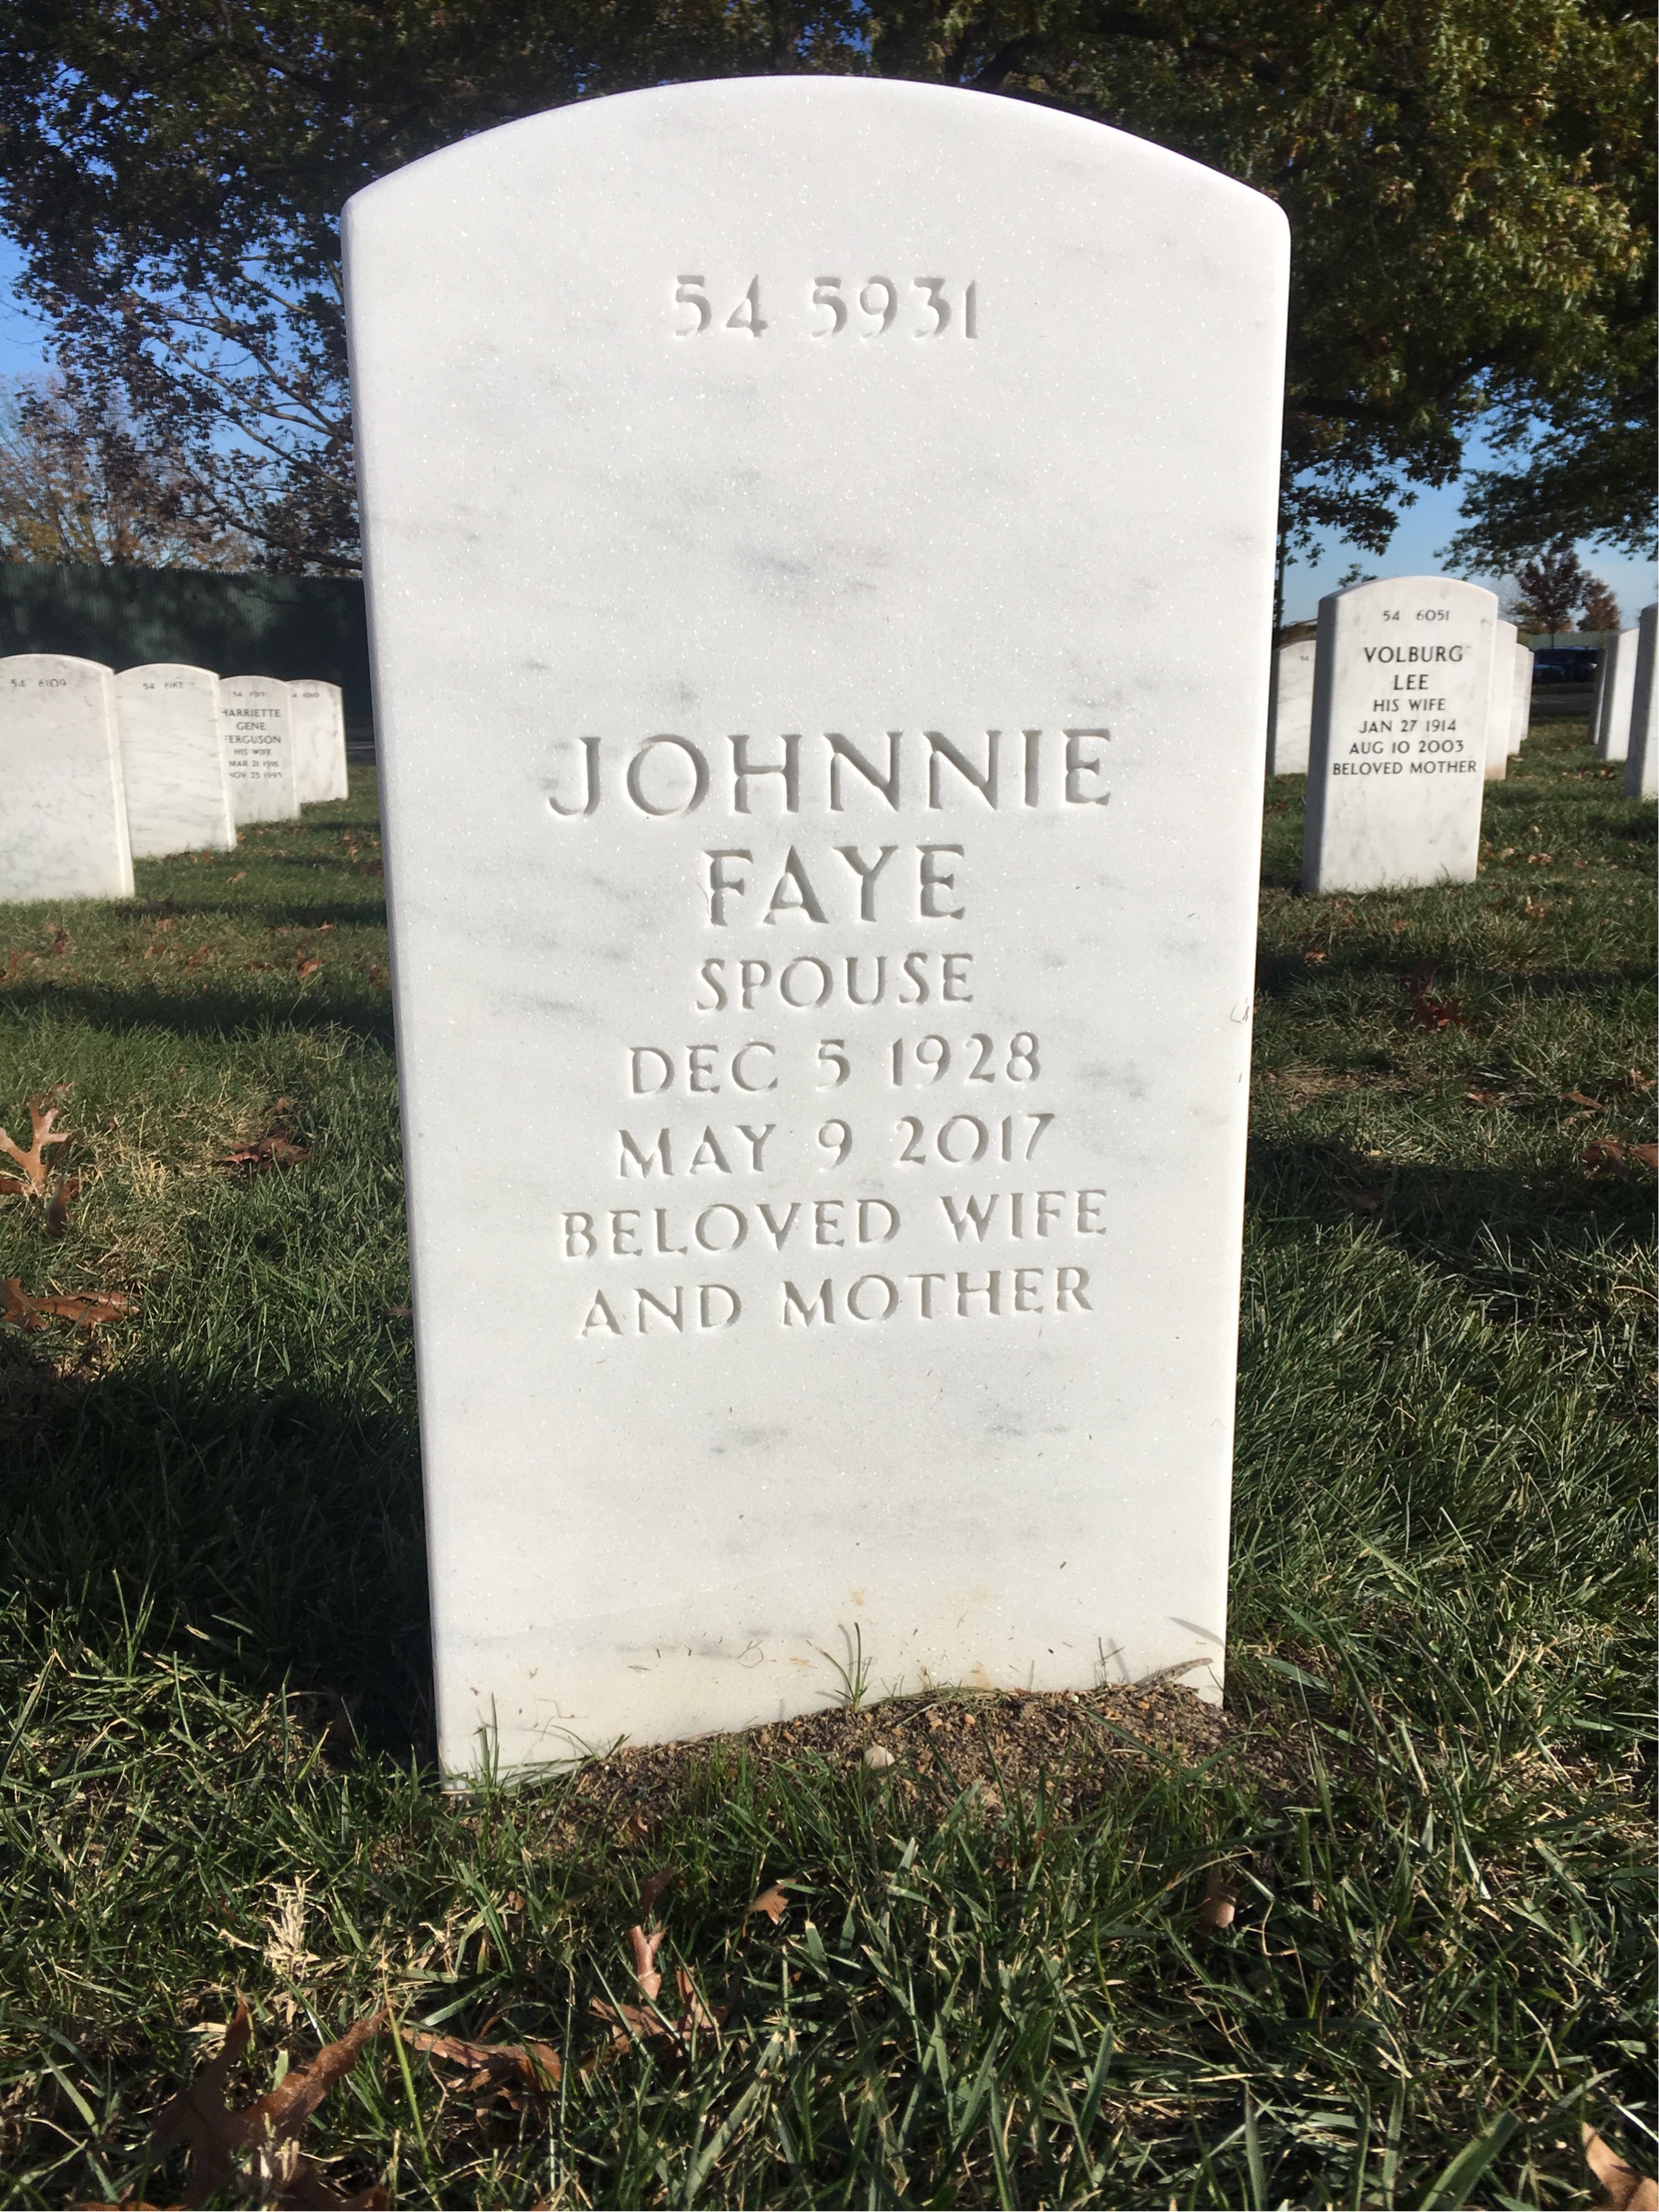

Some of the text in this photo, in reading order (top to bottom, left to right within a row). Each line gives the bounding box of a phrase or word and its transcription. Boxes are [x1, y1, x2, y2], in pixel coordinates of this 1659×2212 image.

[675, 274, 979, 339] 54 5931
[1382, 610, 1450, 622] 54 6051
[1364, 645, 1463, 664] VOLBURG
[1394, 674, 1430, 691] LEE
[1373, 698, 1446, 712] HIS WIFE
[236, 721, 267, 731] GENE
[1358, 719, 1457, 734] JAN 27 1914
[1349, 739, 1464, 755] AUG 10 2003
[229, 760, 248, 768] MAR
[548, 729, 1111, 816] JOHNNIE
[1333, 760, 1477, 776] BELOVED MOTHER
[703, 845, 965, 926] FAYE
[697, 953, 974, 1011] SPOUSE
[629, 1032, 1040, 1095] DEC 5 1928
[618, 1112, 1056, 1179] MAY 9 2017
[560, 1188, 1108, 1259] BELOVED WIFE
[581, 1266, 1094, 1336] AND MOTHER
